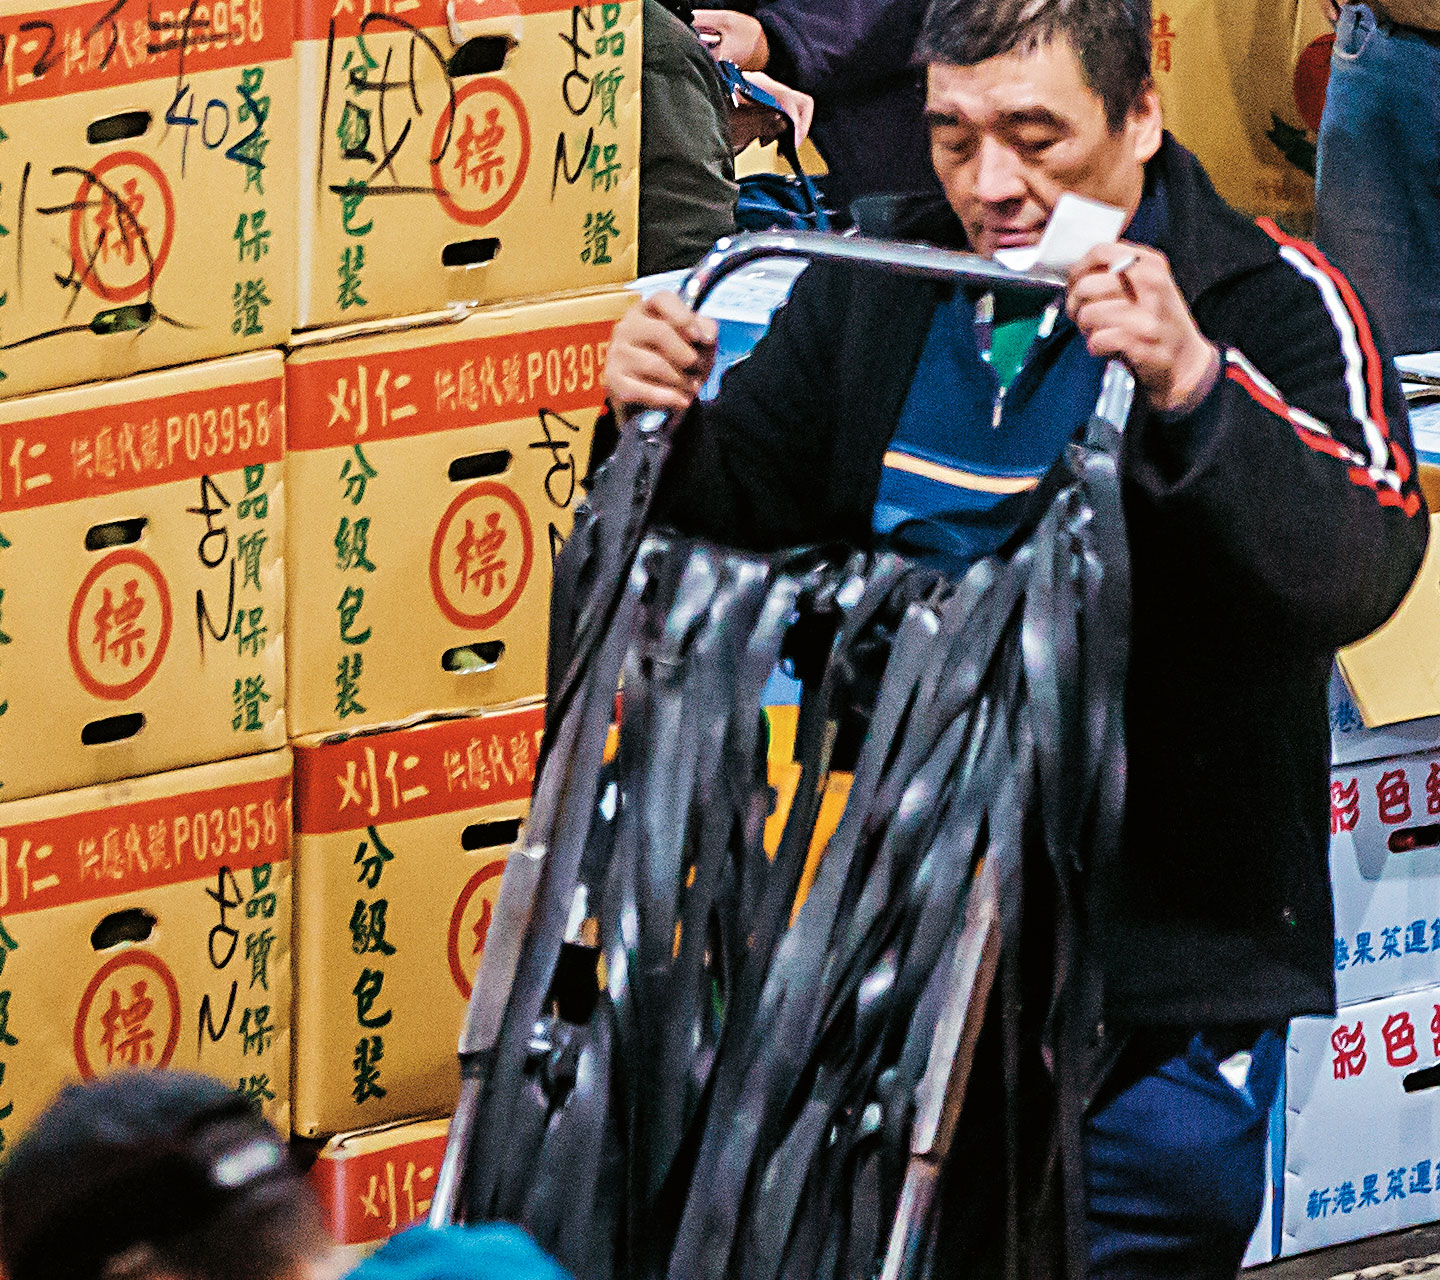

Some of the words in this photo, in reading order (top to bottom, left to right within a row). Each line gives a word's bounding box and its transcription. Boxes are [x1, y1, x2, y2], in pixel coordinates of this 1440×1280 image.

[457, 114, 508, 189] 標
[329, 365, 417, 425] 刈仁
[334, 446, 377, 717] 分級包裝
[453, 524, 506, 597] 標
[92, 597, 146, 671] 標
[232, 463, 270, 734] 品質保證
[338, 747, 428, 816] 刈仁
[349, 828, 396, 1102] 分級包裝
[100, 1004, 152, 1073] 標
